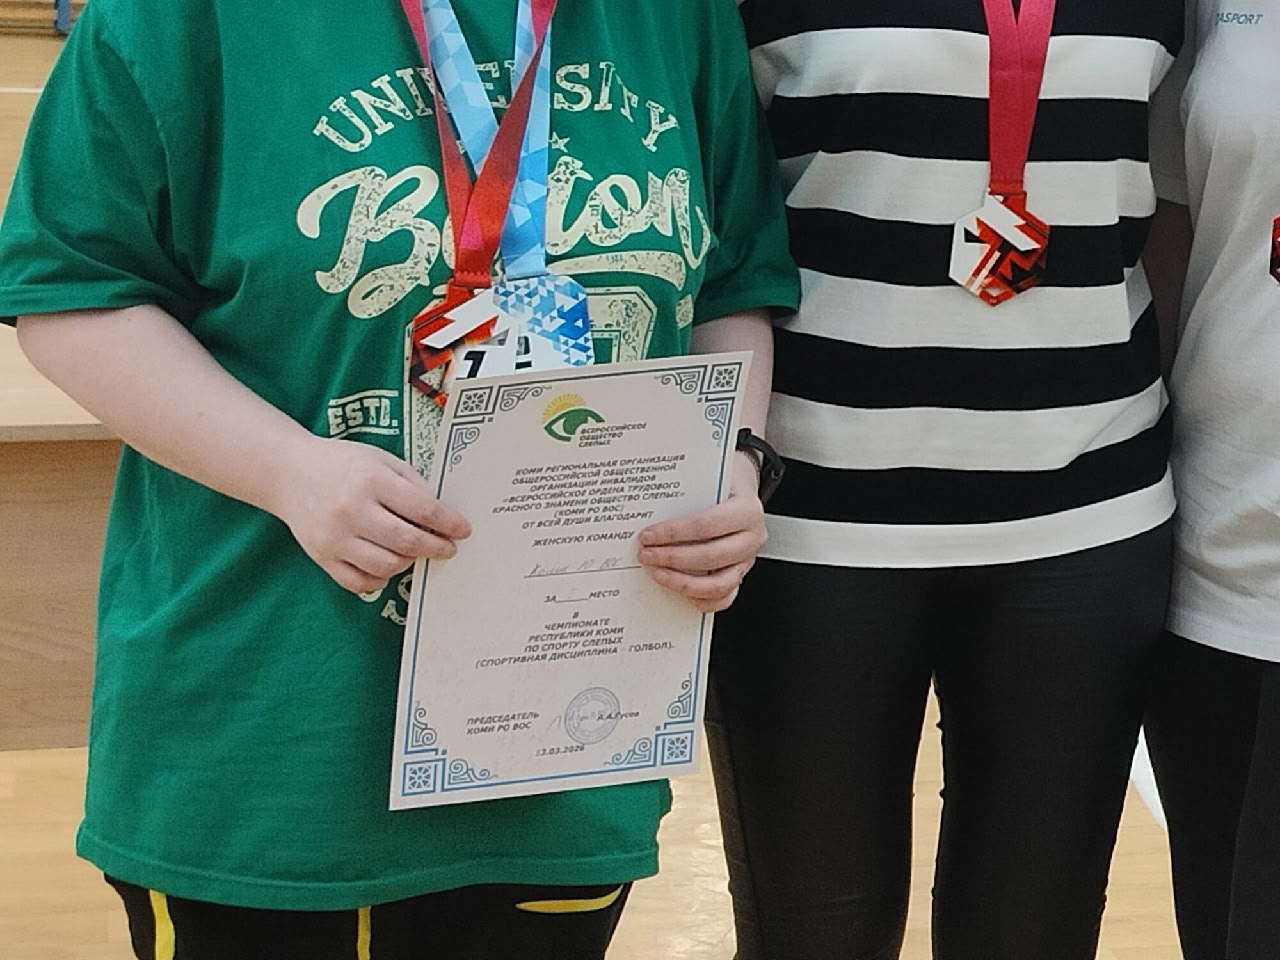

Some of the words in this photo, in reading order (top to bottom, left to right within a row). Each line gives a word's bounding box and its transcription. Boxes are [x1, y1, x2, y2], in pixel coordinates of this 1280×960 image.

[580, 422, 647, 435] ВСЕРОССИЙСКОЕ
[578, 439, 612, 448] СЛЕПЫХ
[579, 432, 623, 442] ОБЩЕСТВО
[515, 467, 543, 477] КОМИ
[545, 459, 618, 473] РЕГИОНАЛЬНАЯ
[619, 453, 685, 467] ОРГАНИЗАЦИЯ
[512, 469, 601, 486] ОБЩЕРОССИЙСКОЙ
[603, 462, 677, 477] ОБЩЕСТВЕННОЙ
[530, 479, 598, 493] ОРГАНИЗАЦИИ
[600, 474, 656, 486] ИНВАЛИДОВ
[588, 486, 625, 497] ОРДЕНА
[627, 481, 680, 493] ТРУДОВОГО
[492, 502, 542, 514] КРАСНОГО
[543, 498, 588, 510] ЗНАМЕНИ
[590, 493, 640, 505] ОБЩЕСТВО
[553, 506, 586, 519] (КОМИ
[587, 505, 600, 514] РО
[602, 503, 624, 513] ВОС)
[521, 521, 536, 530] ОТ
[536, 518, 561, 528] ВСЕЙ
[562, 515, 592, 527] ДУШИ
[593, 511, 655, 523] БЛАГОДАРИТ
[532, 535, 584, 547] ЖЕНСКУЮ
[585, 530, 635, 542] КОМАНДУ
[544, 595, 557, 603] ЗА
[588, 589, 620, 599] МЕСТО
[572, 611, 579, 619] В
[544, 618, 611, 631] ЧЕМПИОНАТЕ
[528, 630, 593, 644] РЕСПУБЛИКИ
[595, 626, 624, 637] КОМИ
[524, 644, 539, 653] ПО
[541, 640, 580, 653] СПОРТУ
[581, 636, 623, 648] СЛЕПЫХ
[475, 652, 547, 670] (СПОРТИВНАЯ
[548, 646, 618, 662] ДИСЦИПЛИНА
[467, 711, 540, 726] ПРЕДСЕДАТЕЛЬ
[466, 724, 495, 735] КОМИ
[497, 723, 510, 733] РО
[512, 721, 532, 731] ВОС
